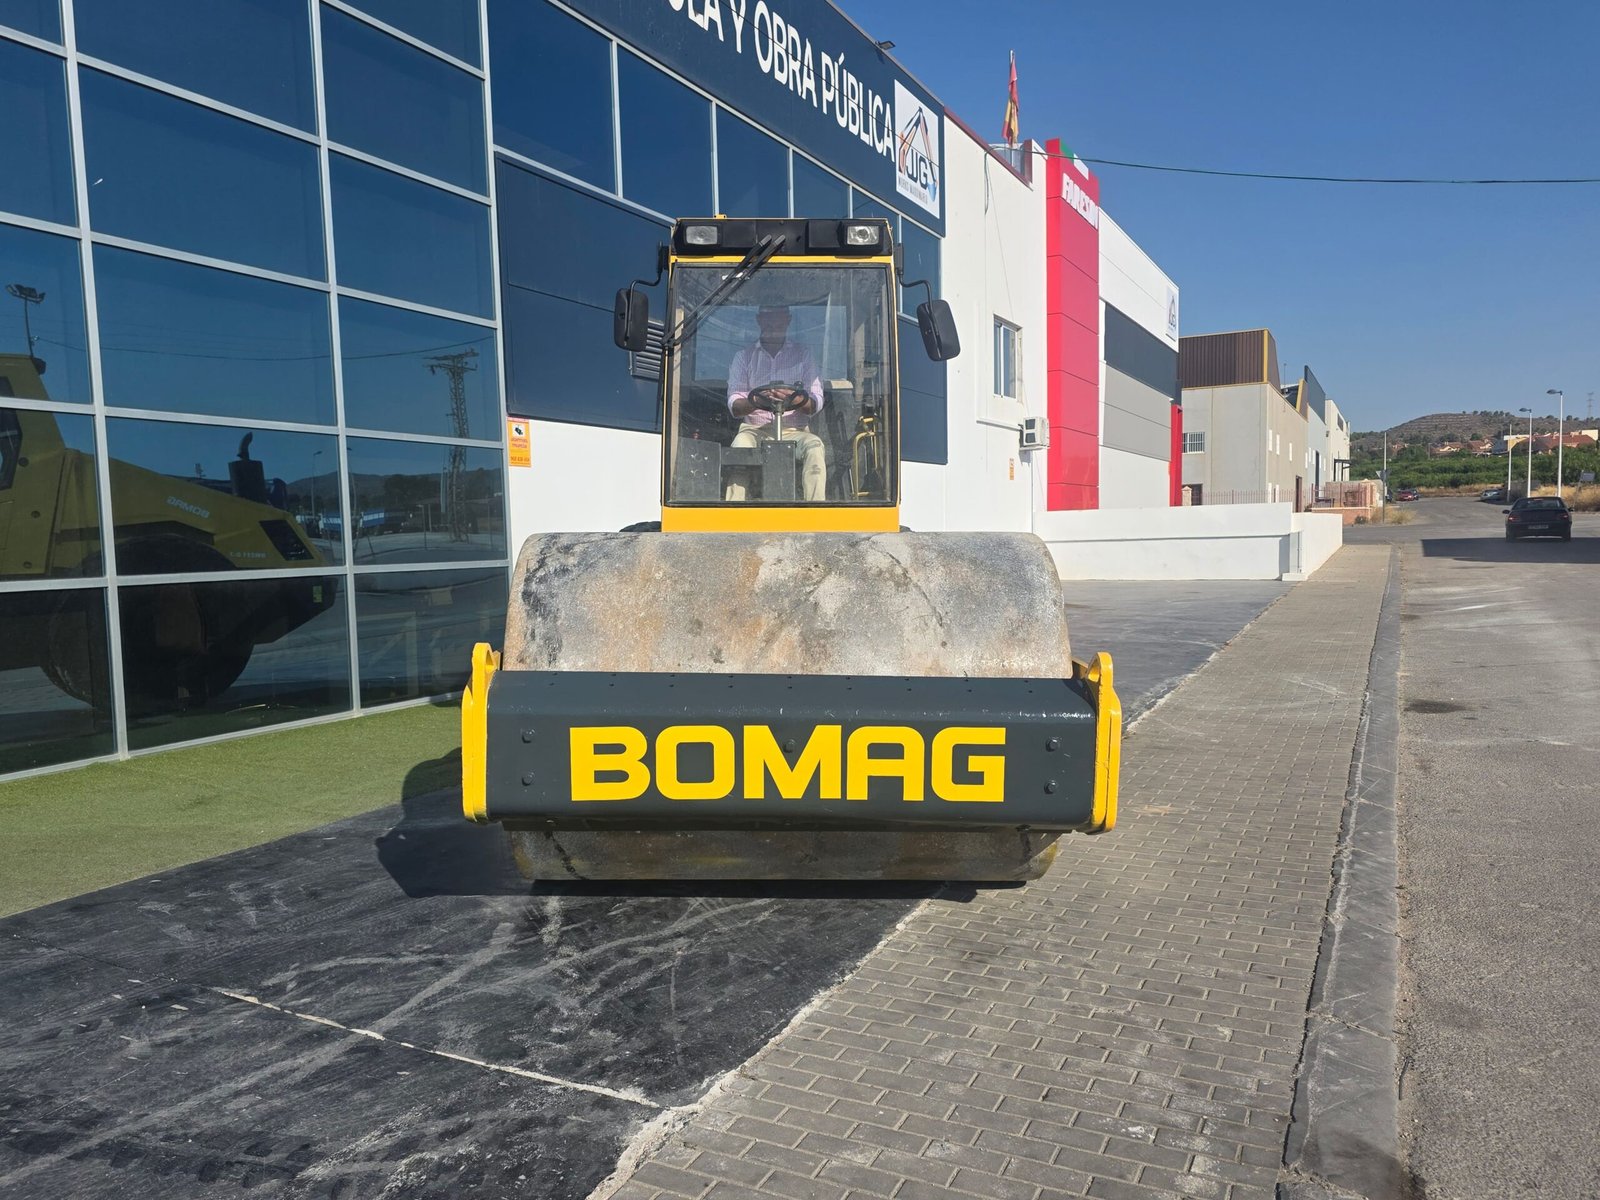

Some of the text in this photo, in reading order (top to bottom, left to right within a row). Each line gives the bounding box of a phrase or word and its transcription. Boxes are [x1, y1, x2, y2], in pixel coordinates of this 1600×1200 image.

[729, 0, 746, 54] Y
[754, 0, 818, 108] OBRA
[821, 51, 895, 162] PÚBLICA
[570, 725, 1006, 802] BOMAG
